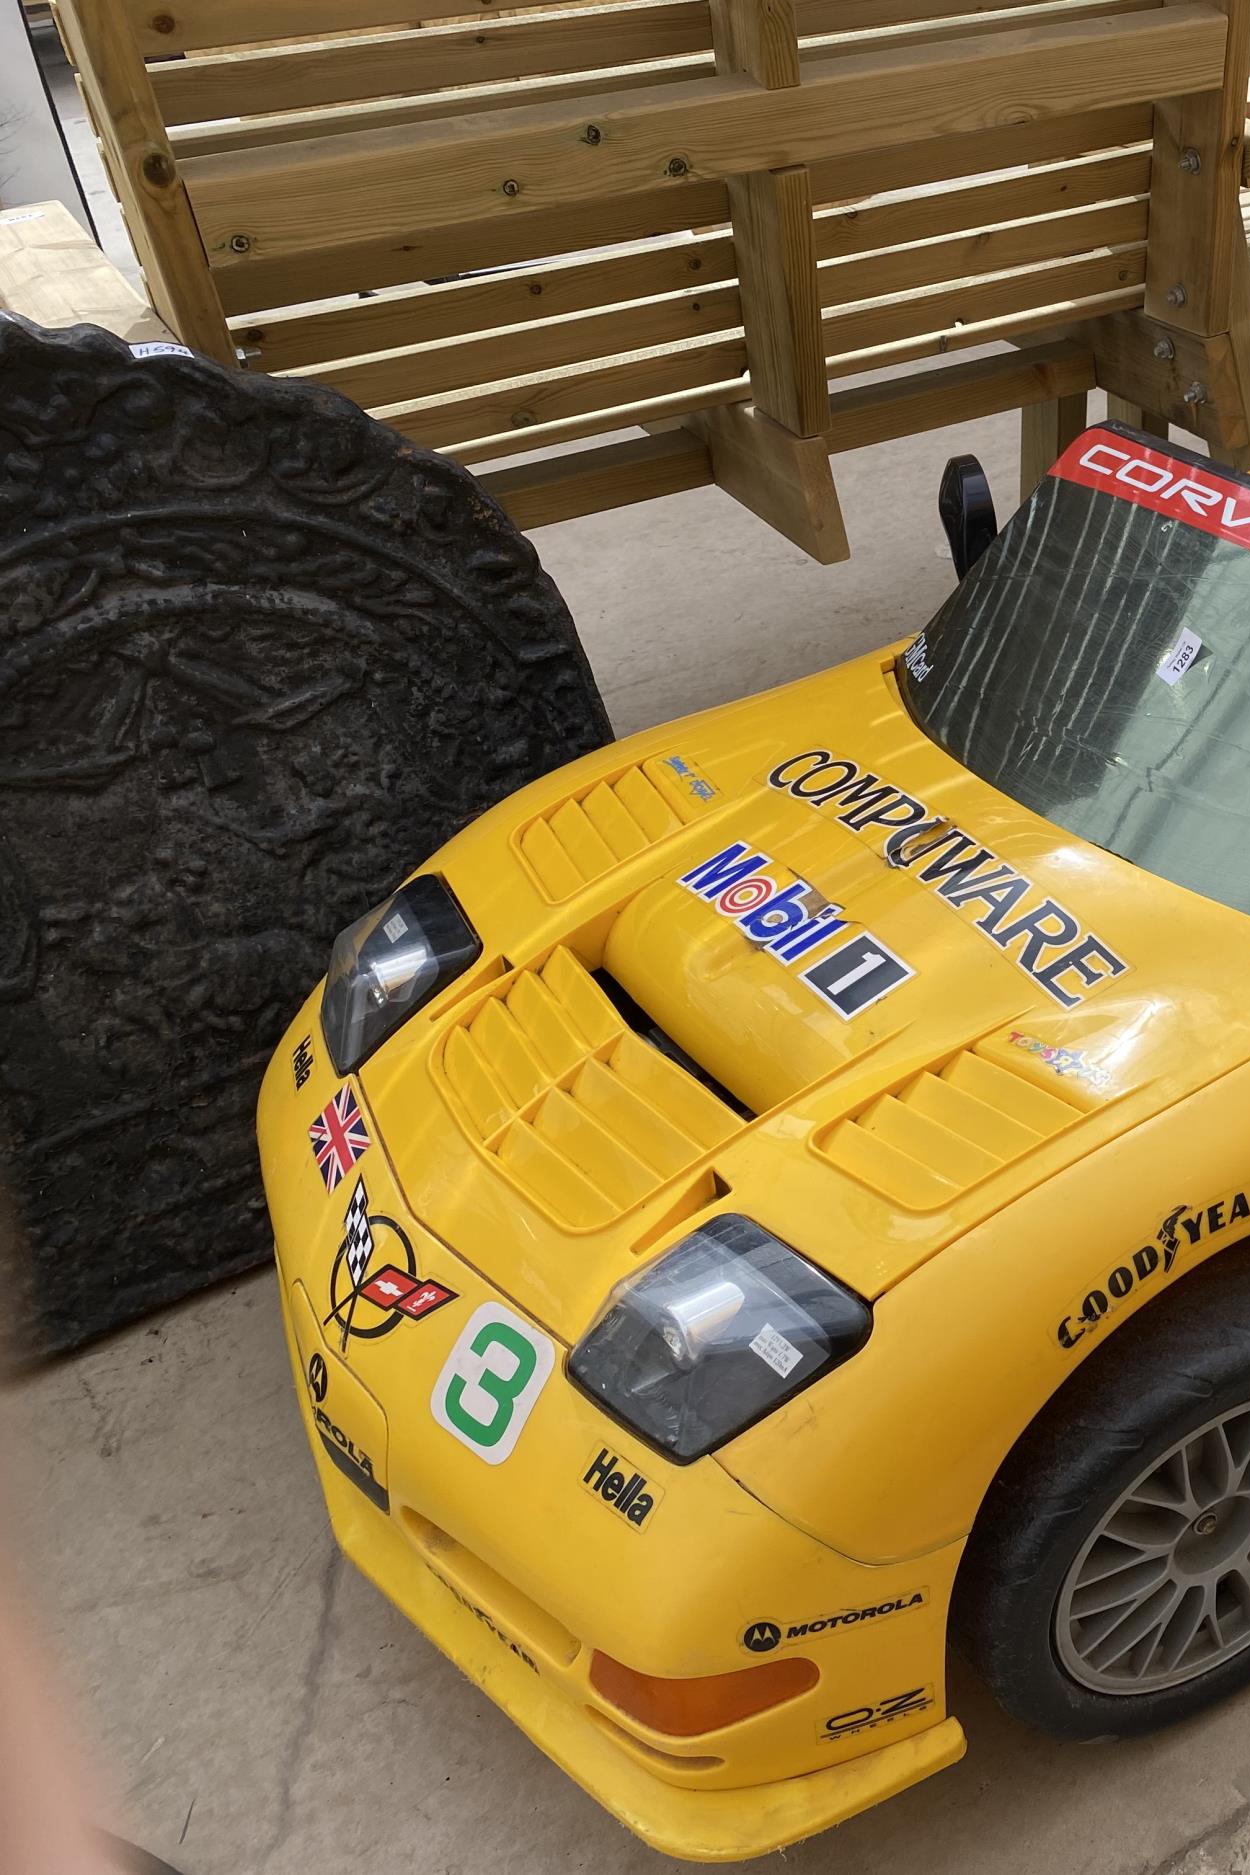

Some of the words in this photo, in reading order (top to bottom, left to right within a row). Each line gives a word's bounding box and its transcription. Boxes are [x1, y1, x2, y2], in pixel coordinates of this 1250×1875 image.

[1172, 644, 1194, 673] 1283
[677, 840, 849, 966] Mobil
[767, 749, 1130, 1012] COMPUWARE
[293, 1034, 313, 1091] Hella
[445, 1321, 539, 1448] 3
[583, 1447, 654, 1527] Hella
[787, 1593, 923, 1639] MOTOROLA
